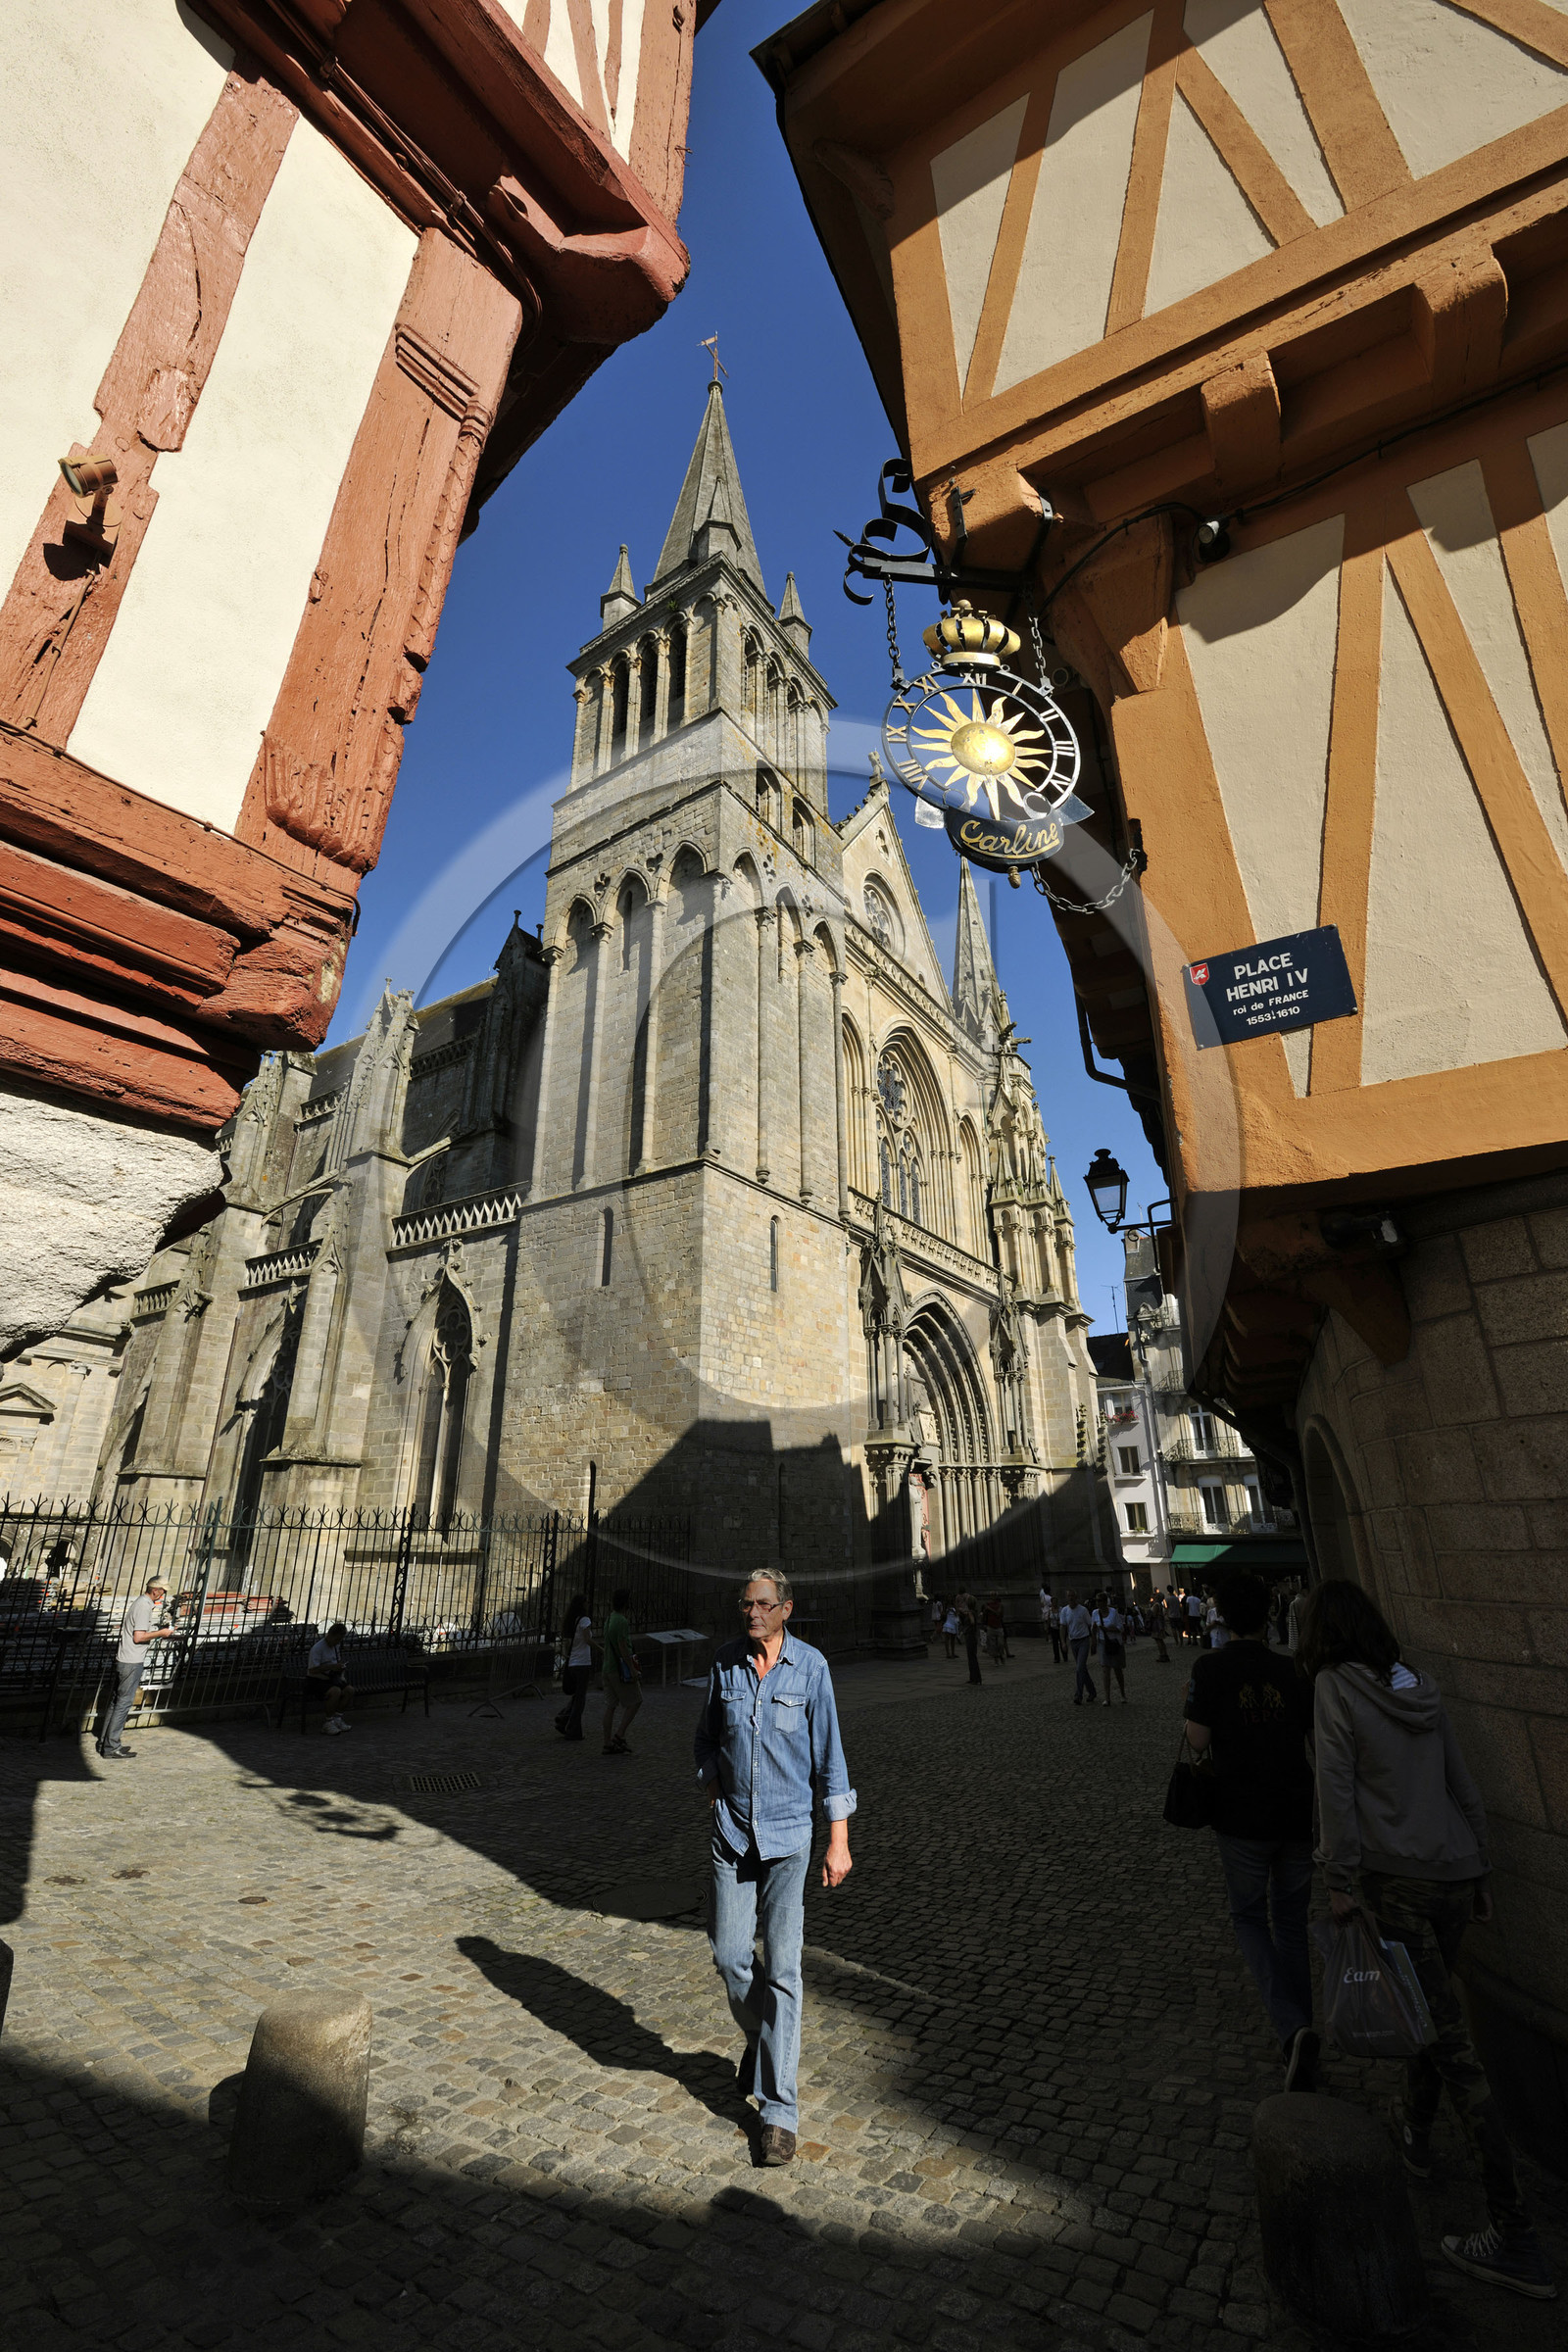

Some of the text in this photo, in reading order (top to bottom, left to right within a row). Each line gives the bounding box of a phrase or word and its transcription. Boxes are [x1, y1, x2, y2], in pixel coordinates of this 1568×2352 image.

[959, 818, 1060, 856] Carline
[1233, 952, 1294, 980] PLACE
[1225, 976, 1279, 1003] HENRI
[1232, 989, 1309, 1016] roi de FRANCE
